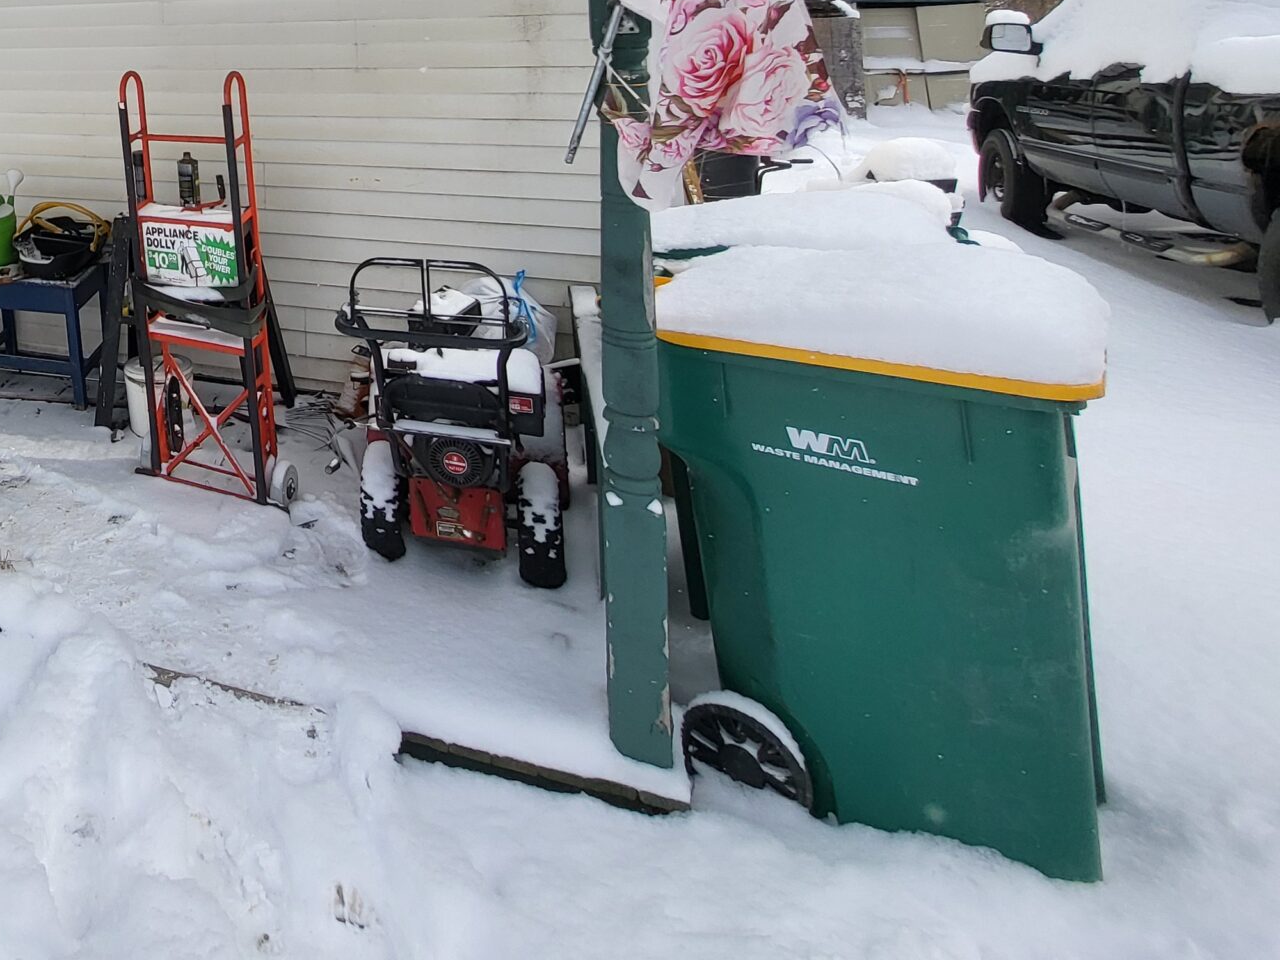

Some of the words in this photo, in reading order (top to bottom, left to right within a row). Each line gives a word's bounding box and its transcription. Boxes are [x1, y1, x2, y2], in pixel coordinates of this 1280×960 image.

[145, 226, 199, 240] APPLIANCE
[146, 237, 176, 250] DOLLY
[201, 244, 235, 260] DOUBLES
[208, 253, 228, 266] YOUR
[205, 260, 231, 274] POWER
[785, 426, 871, 464] WM
[751, 442, 801, 461] WASTE
[803, 454, 919, 486] MANAGEMENT
